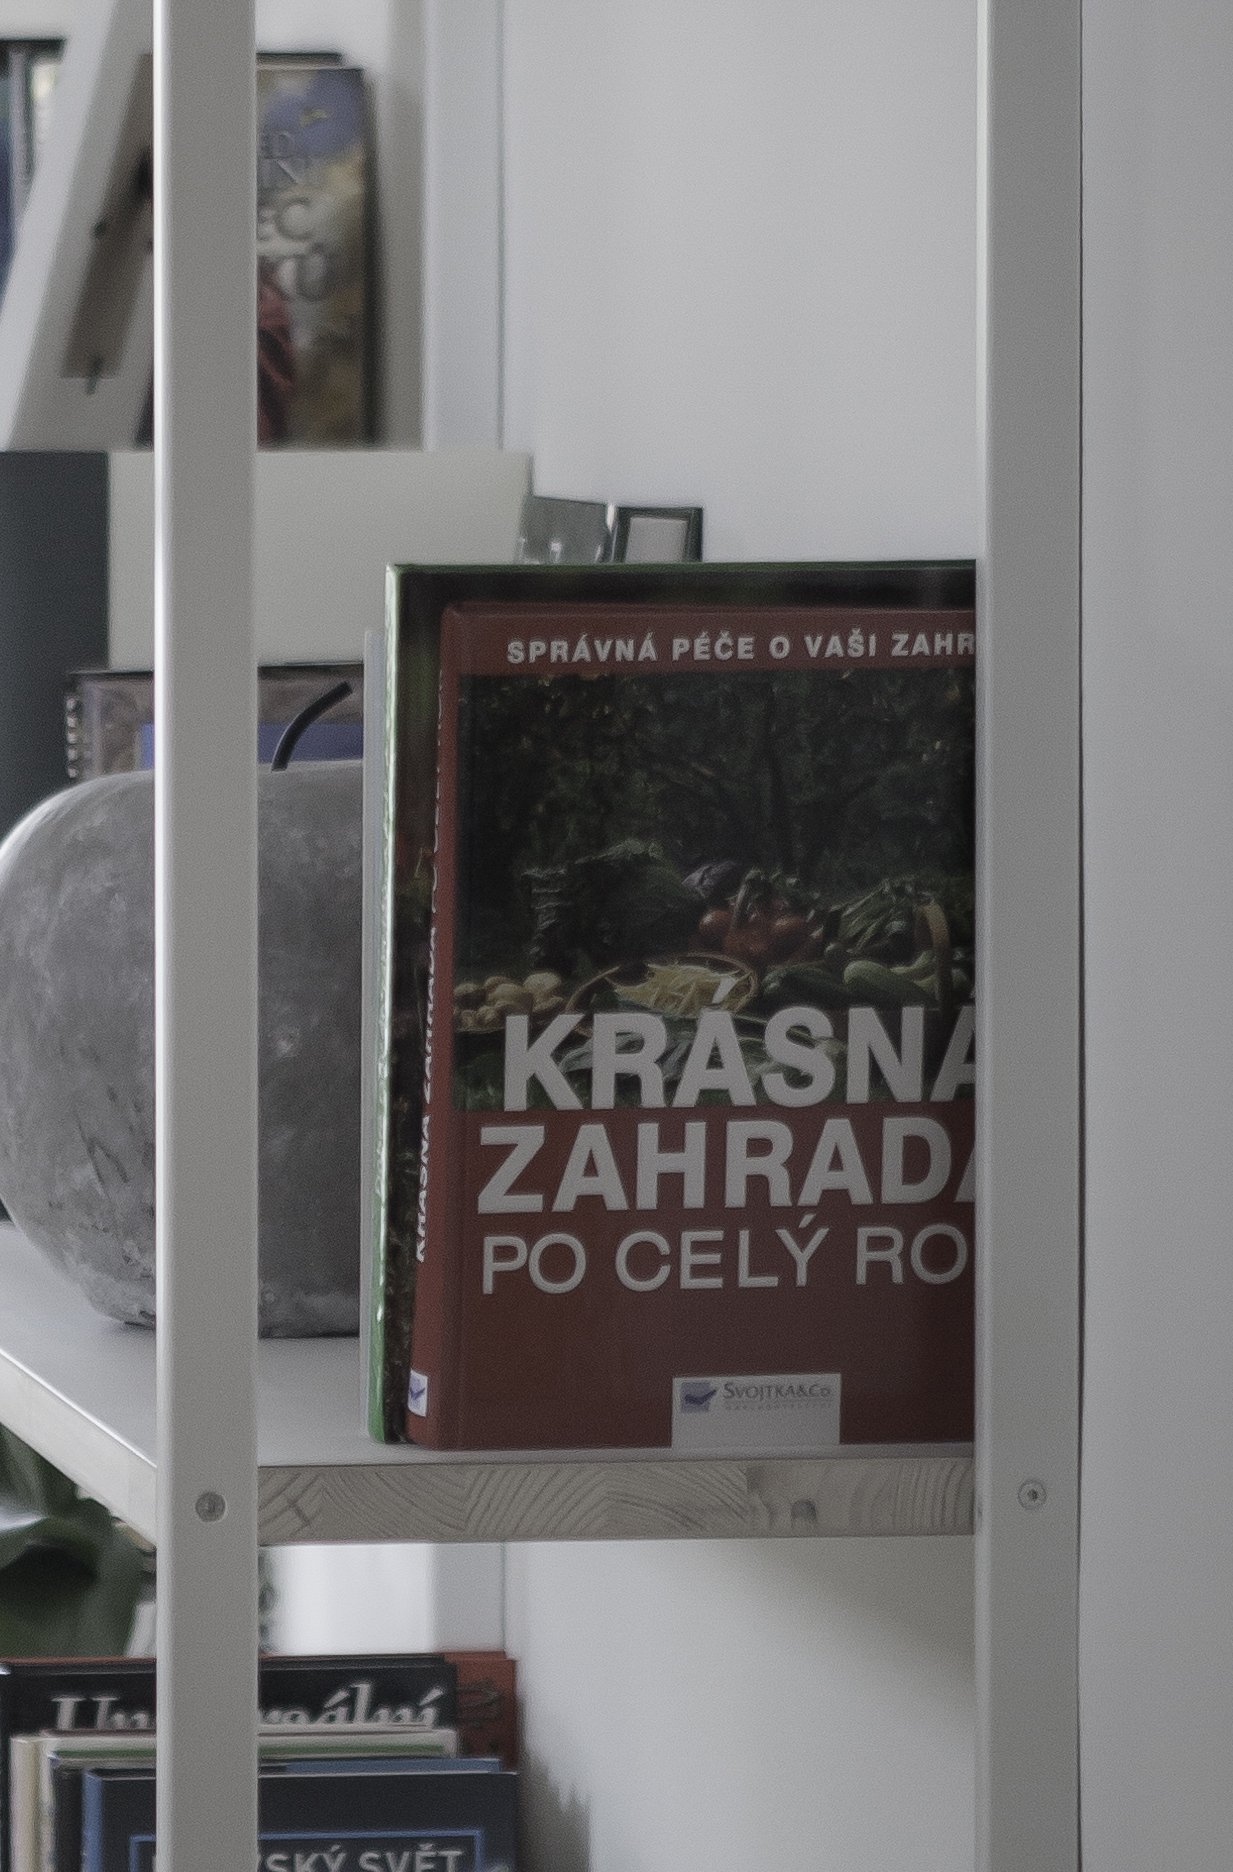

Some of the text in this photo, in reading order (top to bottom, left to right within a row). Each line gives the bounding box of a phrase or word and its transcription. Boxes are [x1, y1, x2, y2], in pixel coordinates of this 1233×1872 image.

[506, 631, 657, 664] SPRÁVNÁ
[672, 627, 755, 660] PÉČE
[768, 635, 790, 660] O
[805, 627, 877, 660] VAŠI
[477, 1118, 975, 1214] ZAHRAD
[483, 1232, 588, 1295] PO
[615, 1214, 830, 1292] CELÝ
